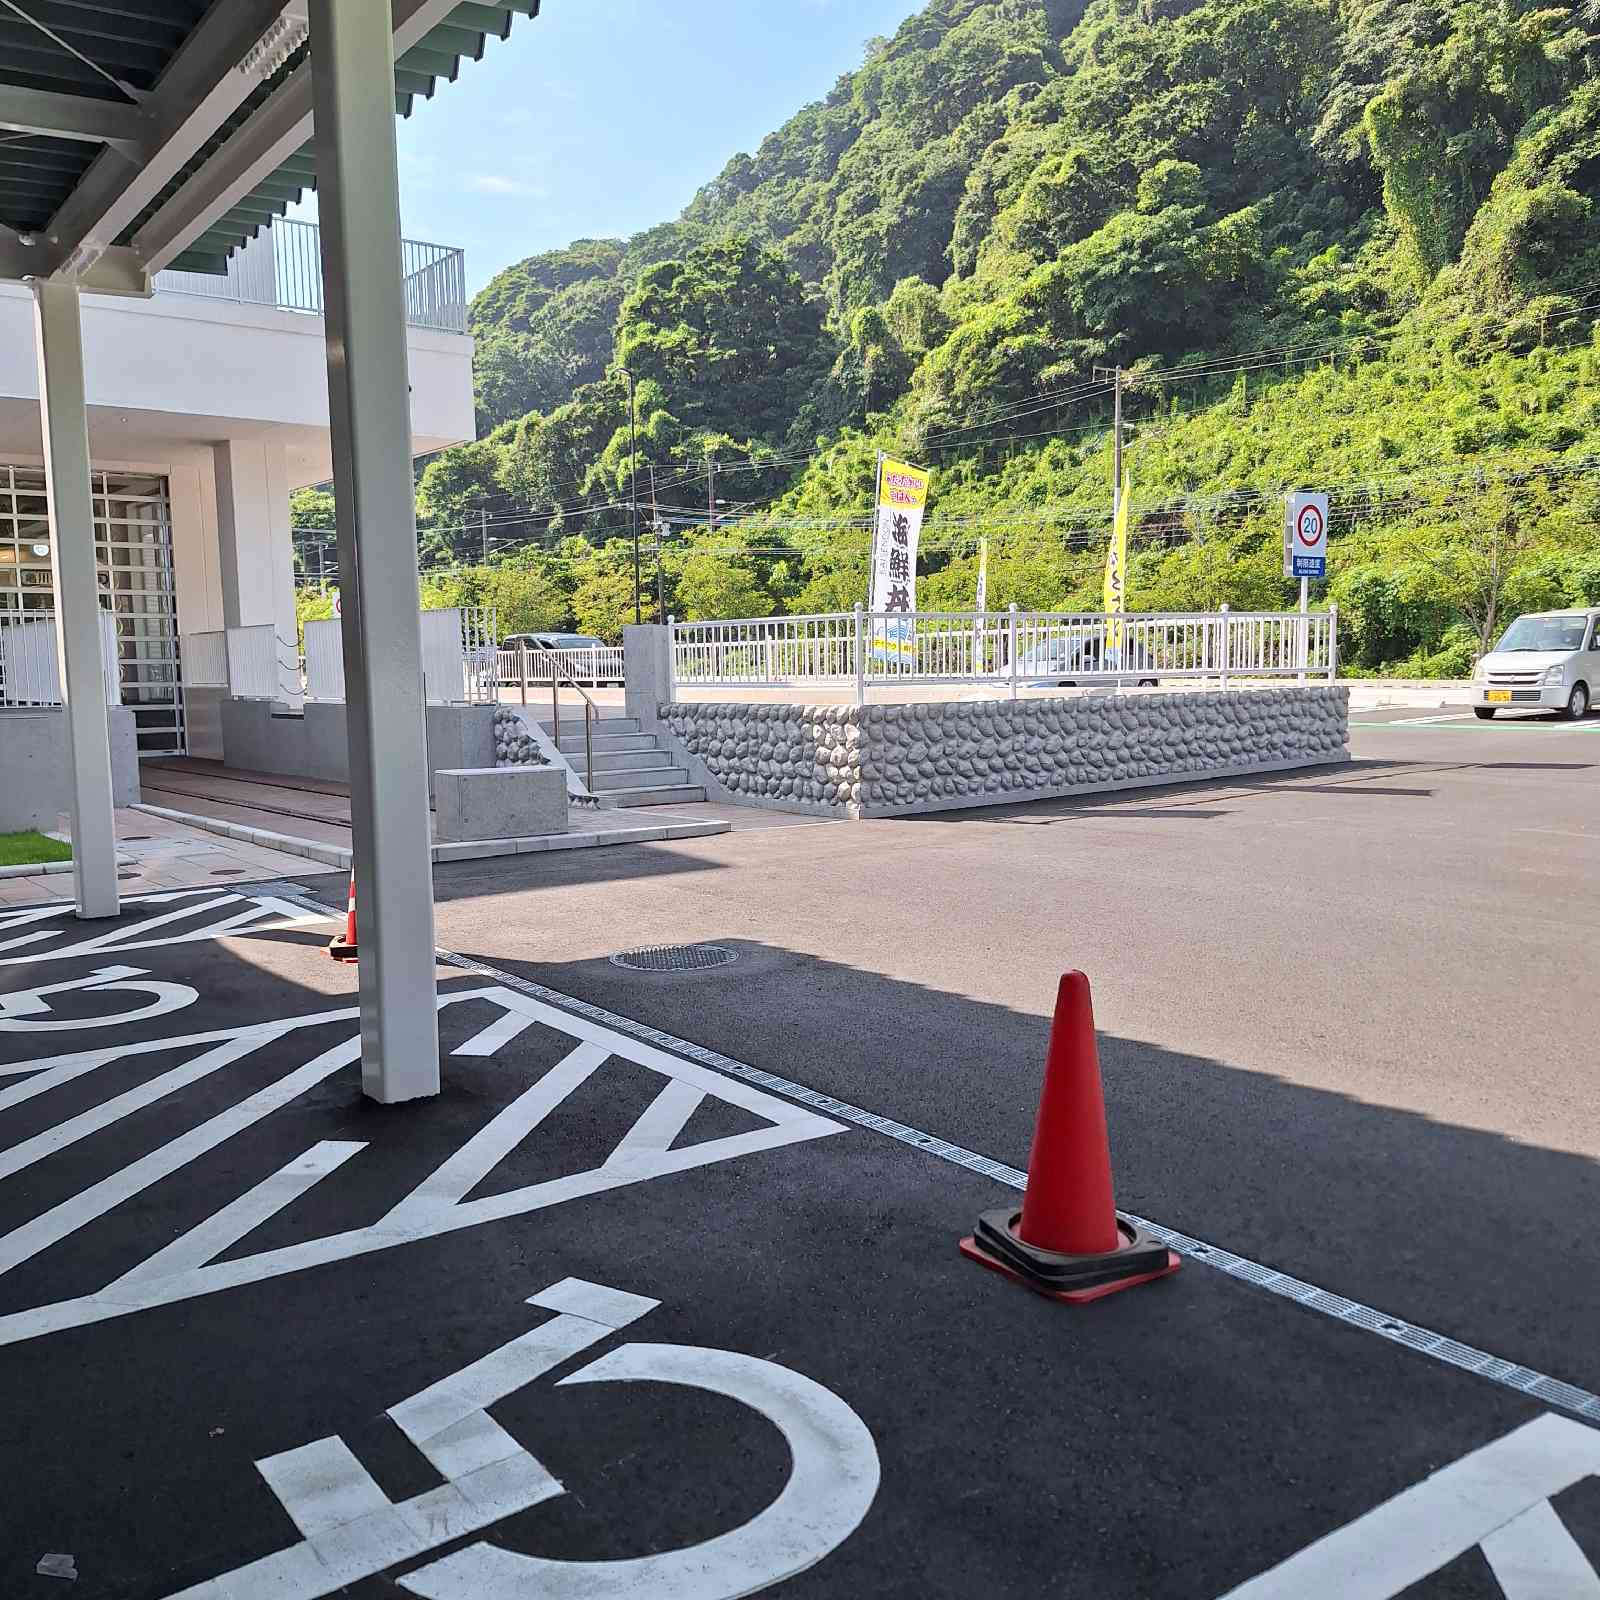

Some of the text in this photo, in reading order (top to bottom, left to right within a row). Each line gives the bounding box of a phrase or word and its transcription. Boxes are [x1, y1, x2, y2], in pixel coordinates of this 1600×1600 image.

[1303, 517, 1318, 535] 20
[885, 512, 911, 612] 海鮮丼
